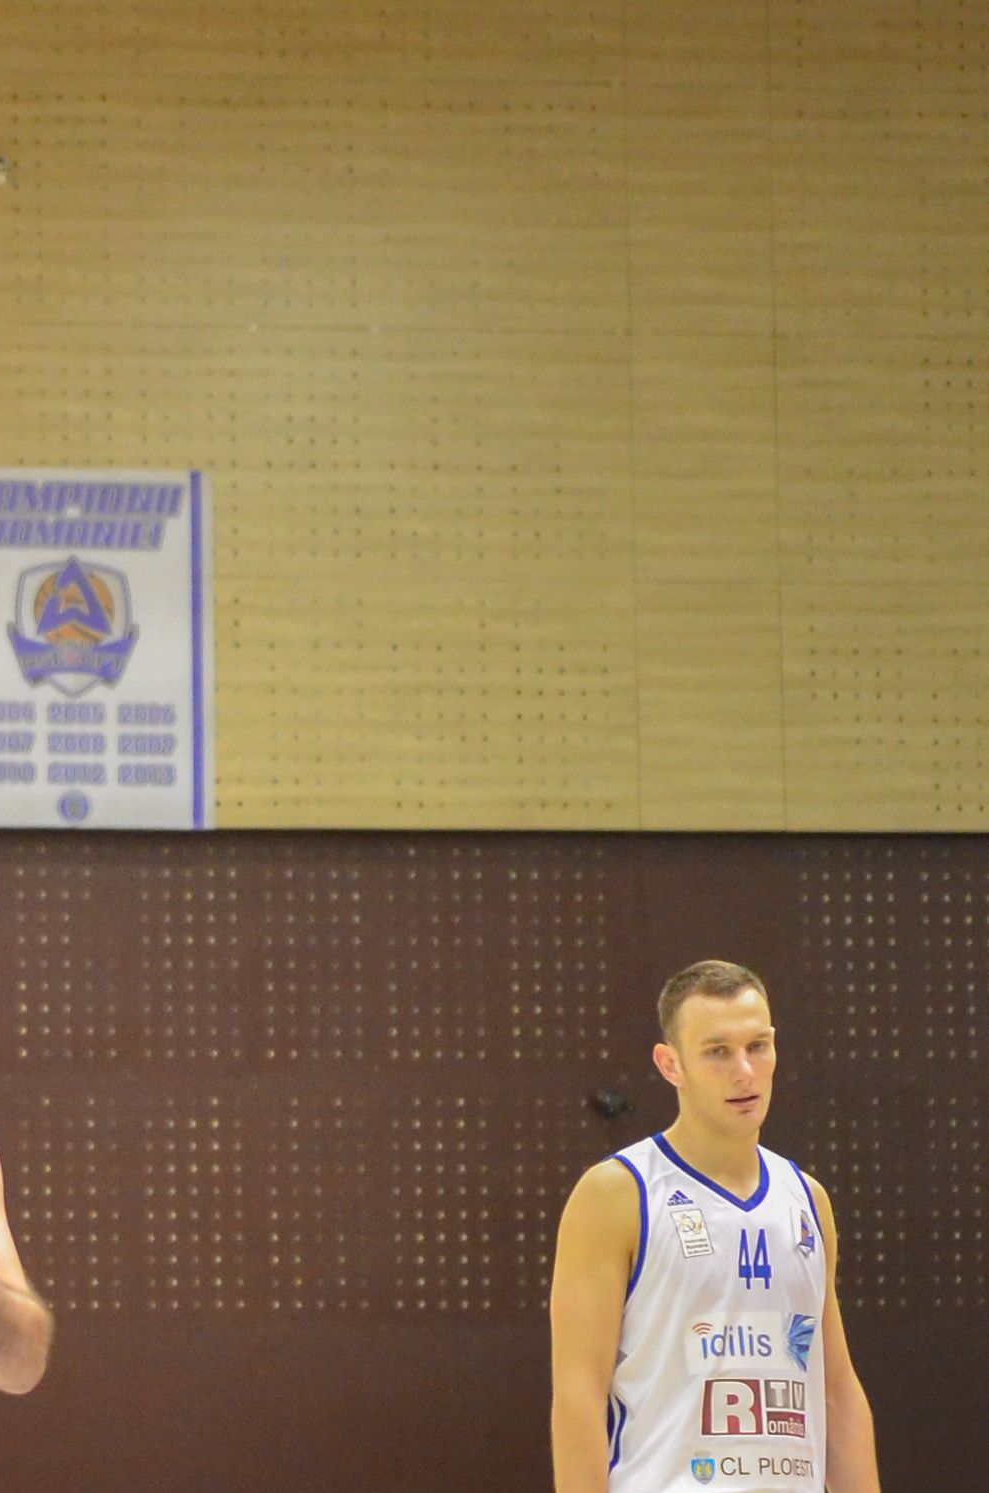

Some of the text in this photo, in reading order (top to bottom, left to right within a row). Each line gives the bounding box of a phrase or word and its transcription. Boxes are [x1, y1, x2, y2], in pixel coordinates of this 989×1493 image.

[738, 1229, 772, 1290] 44
[700, 1324, 772, 1360] idilis
[720, 1457, 751, 1476] CL
